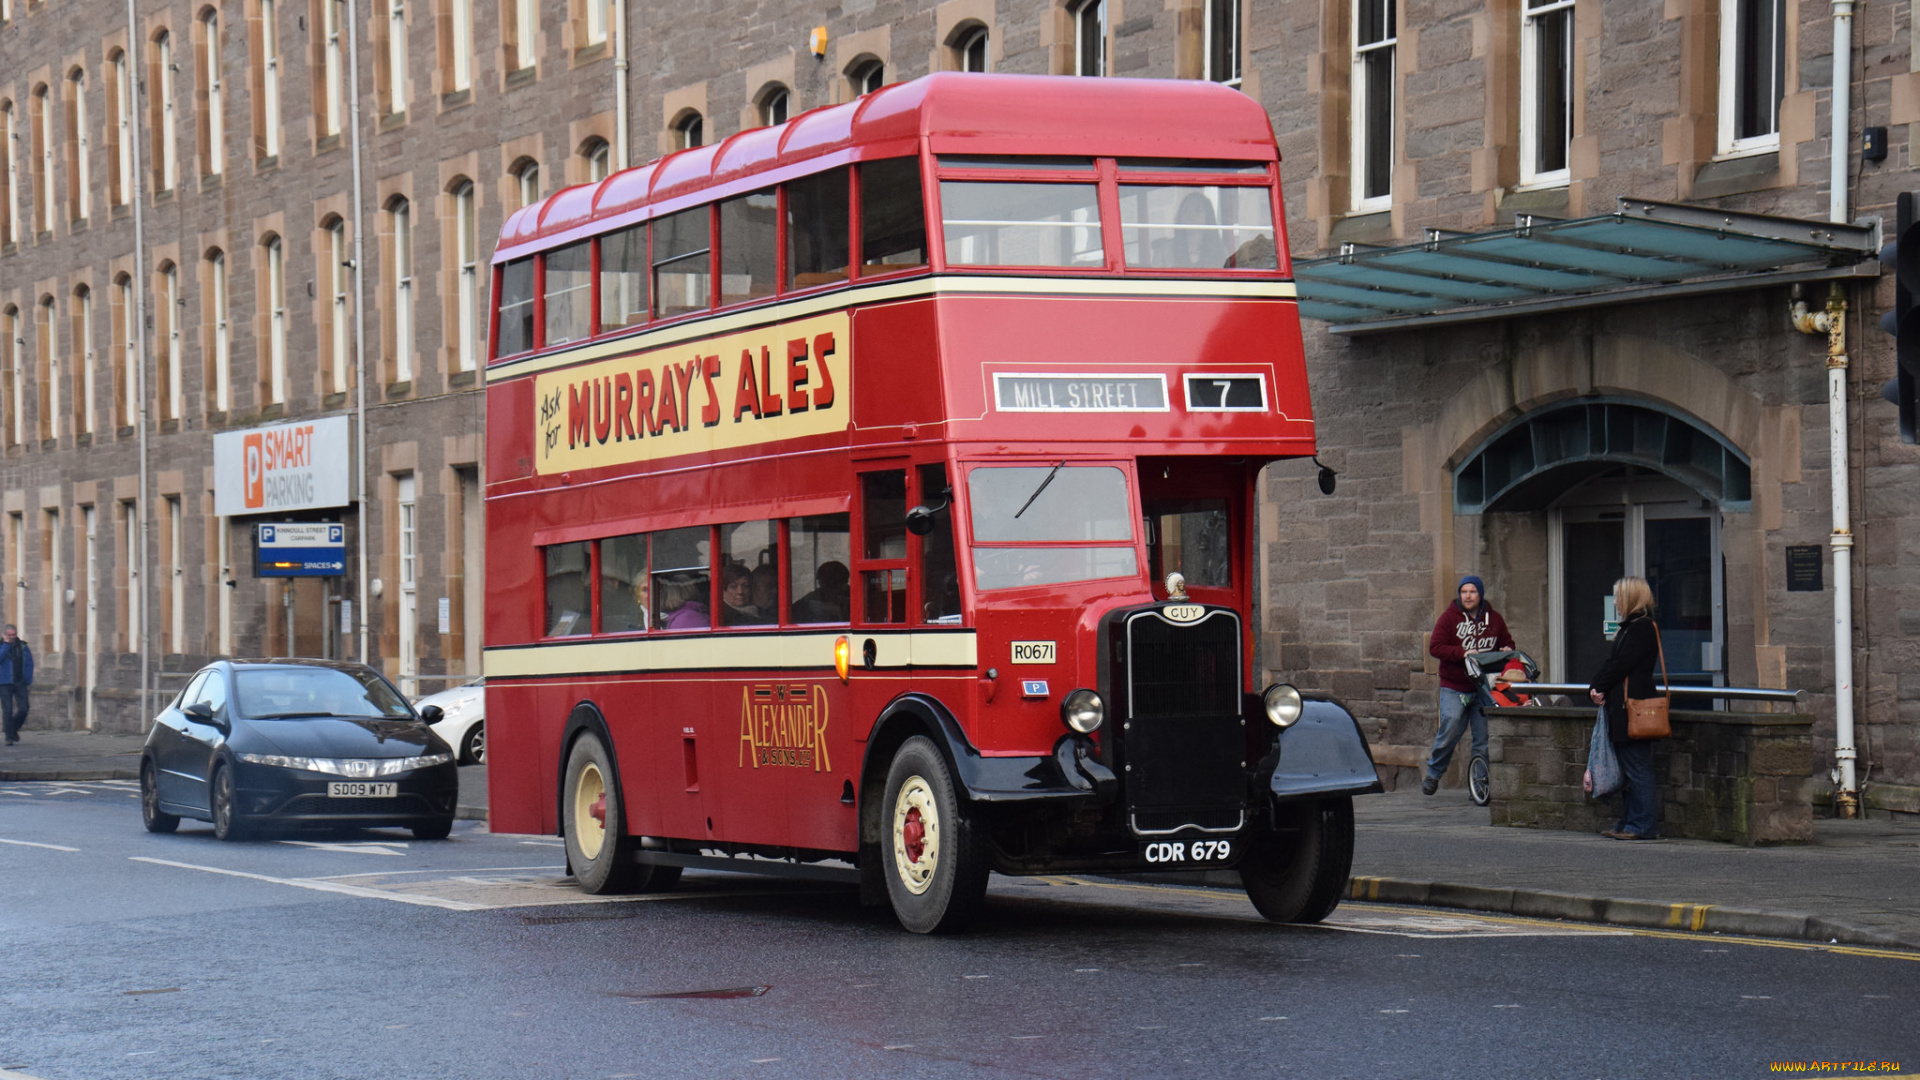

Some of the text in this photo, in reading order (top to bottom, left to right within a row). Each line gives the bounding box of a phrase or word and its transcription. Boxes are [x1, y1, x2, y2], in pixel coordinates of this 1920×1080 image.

[568, 331, 835, 450] MURRAY'S ALES
[1014, 382, 1138, 408] MILL STREET
[1212, 380, 1231, 408] 7
[541, 387, 561, 426] Ask
[265, 425, 314, 471] SMART
[545, 422, 561, 459] for
[266, 472, 314, 507] PARKING
[263, 528, 274, 540] P
[331, 528, 341, 540] P
[1171, 607, 1199, 618] GUY
[1032, 683, 1040, 693] P
[761, 747, 769, 766] &
[333, 783, 393, 796] SD09 WTY
[1145, 840, 1230, 863] CDR 679
